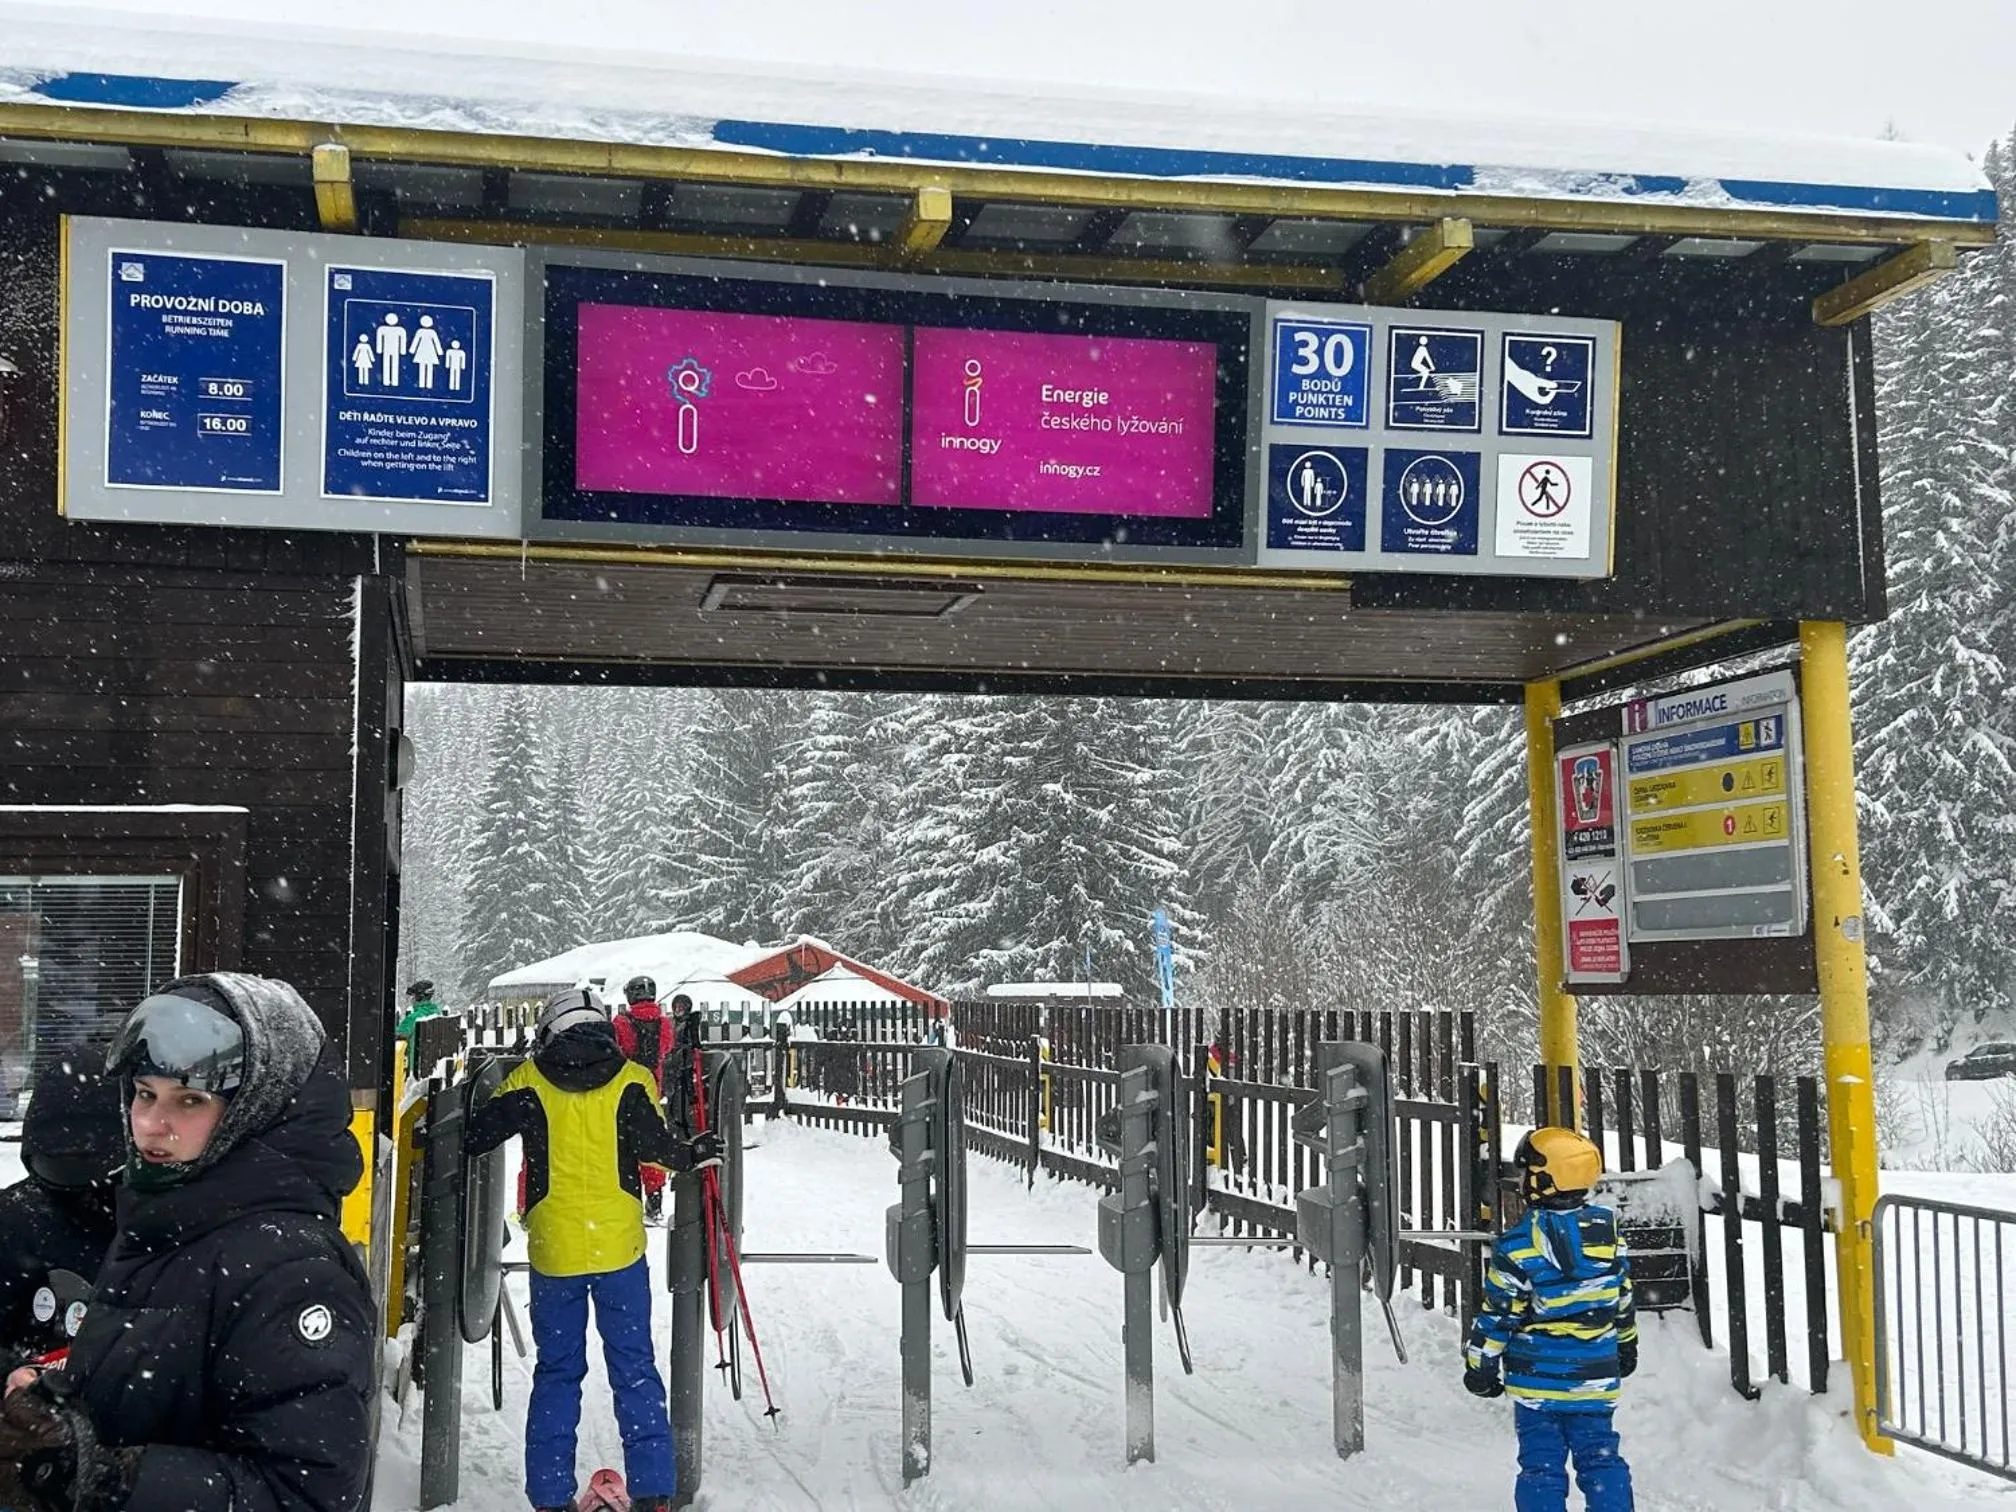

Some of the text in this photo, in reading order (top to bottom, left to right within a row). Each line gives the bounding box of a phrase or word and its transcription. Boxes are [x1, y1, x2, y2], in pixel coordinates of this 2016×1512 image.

[218, 299, 265, 316] DOBA
[162, 314, 233, 327] BETRIEBSZEITEN
[165, 325, 229, 337] RUNNING TIME
[1291, 331, 1354, 377] 30
[208, 382, 244, 396] 8.00
[1041, 384, 1109, 408] Energie
[1289, 392, 1353, 406] PUNKTEN
[339, 411, 361, 421] DĚTI
[396, 415, 428, 426] VLEVO
[429, 417, 439, 426] A
[439, 418, 478, 428] VPRAVO
[1295, 406, 1345, 419] POINTS
[203, 417, 247, 431] 16.00
[1041, 412, 1184, 436] českého lyžování
[367, 428, 393, 438] Kinder
[395, 429, 417, 439] beim
[400, 439, 416, 447] und
[941, 432, 1001, 454] innogy
[338, 448, 372, 458] Children
[386, 451, 399, 459] the
[401, 451, 414, 460] left
[416, 453, 431, 461] and
[432, 453, 441, 462] to
[443, 454, 456, 463] the
[458, 456, 477, 465] right
[360, 459, 383, 467] when
[428, 463, 442, 471] the
[1040, 461, 1101, 478] innogy.cz
[1657, 694, 1728, 724] INFORMACE
